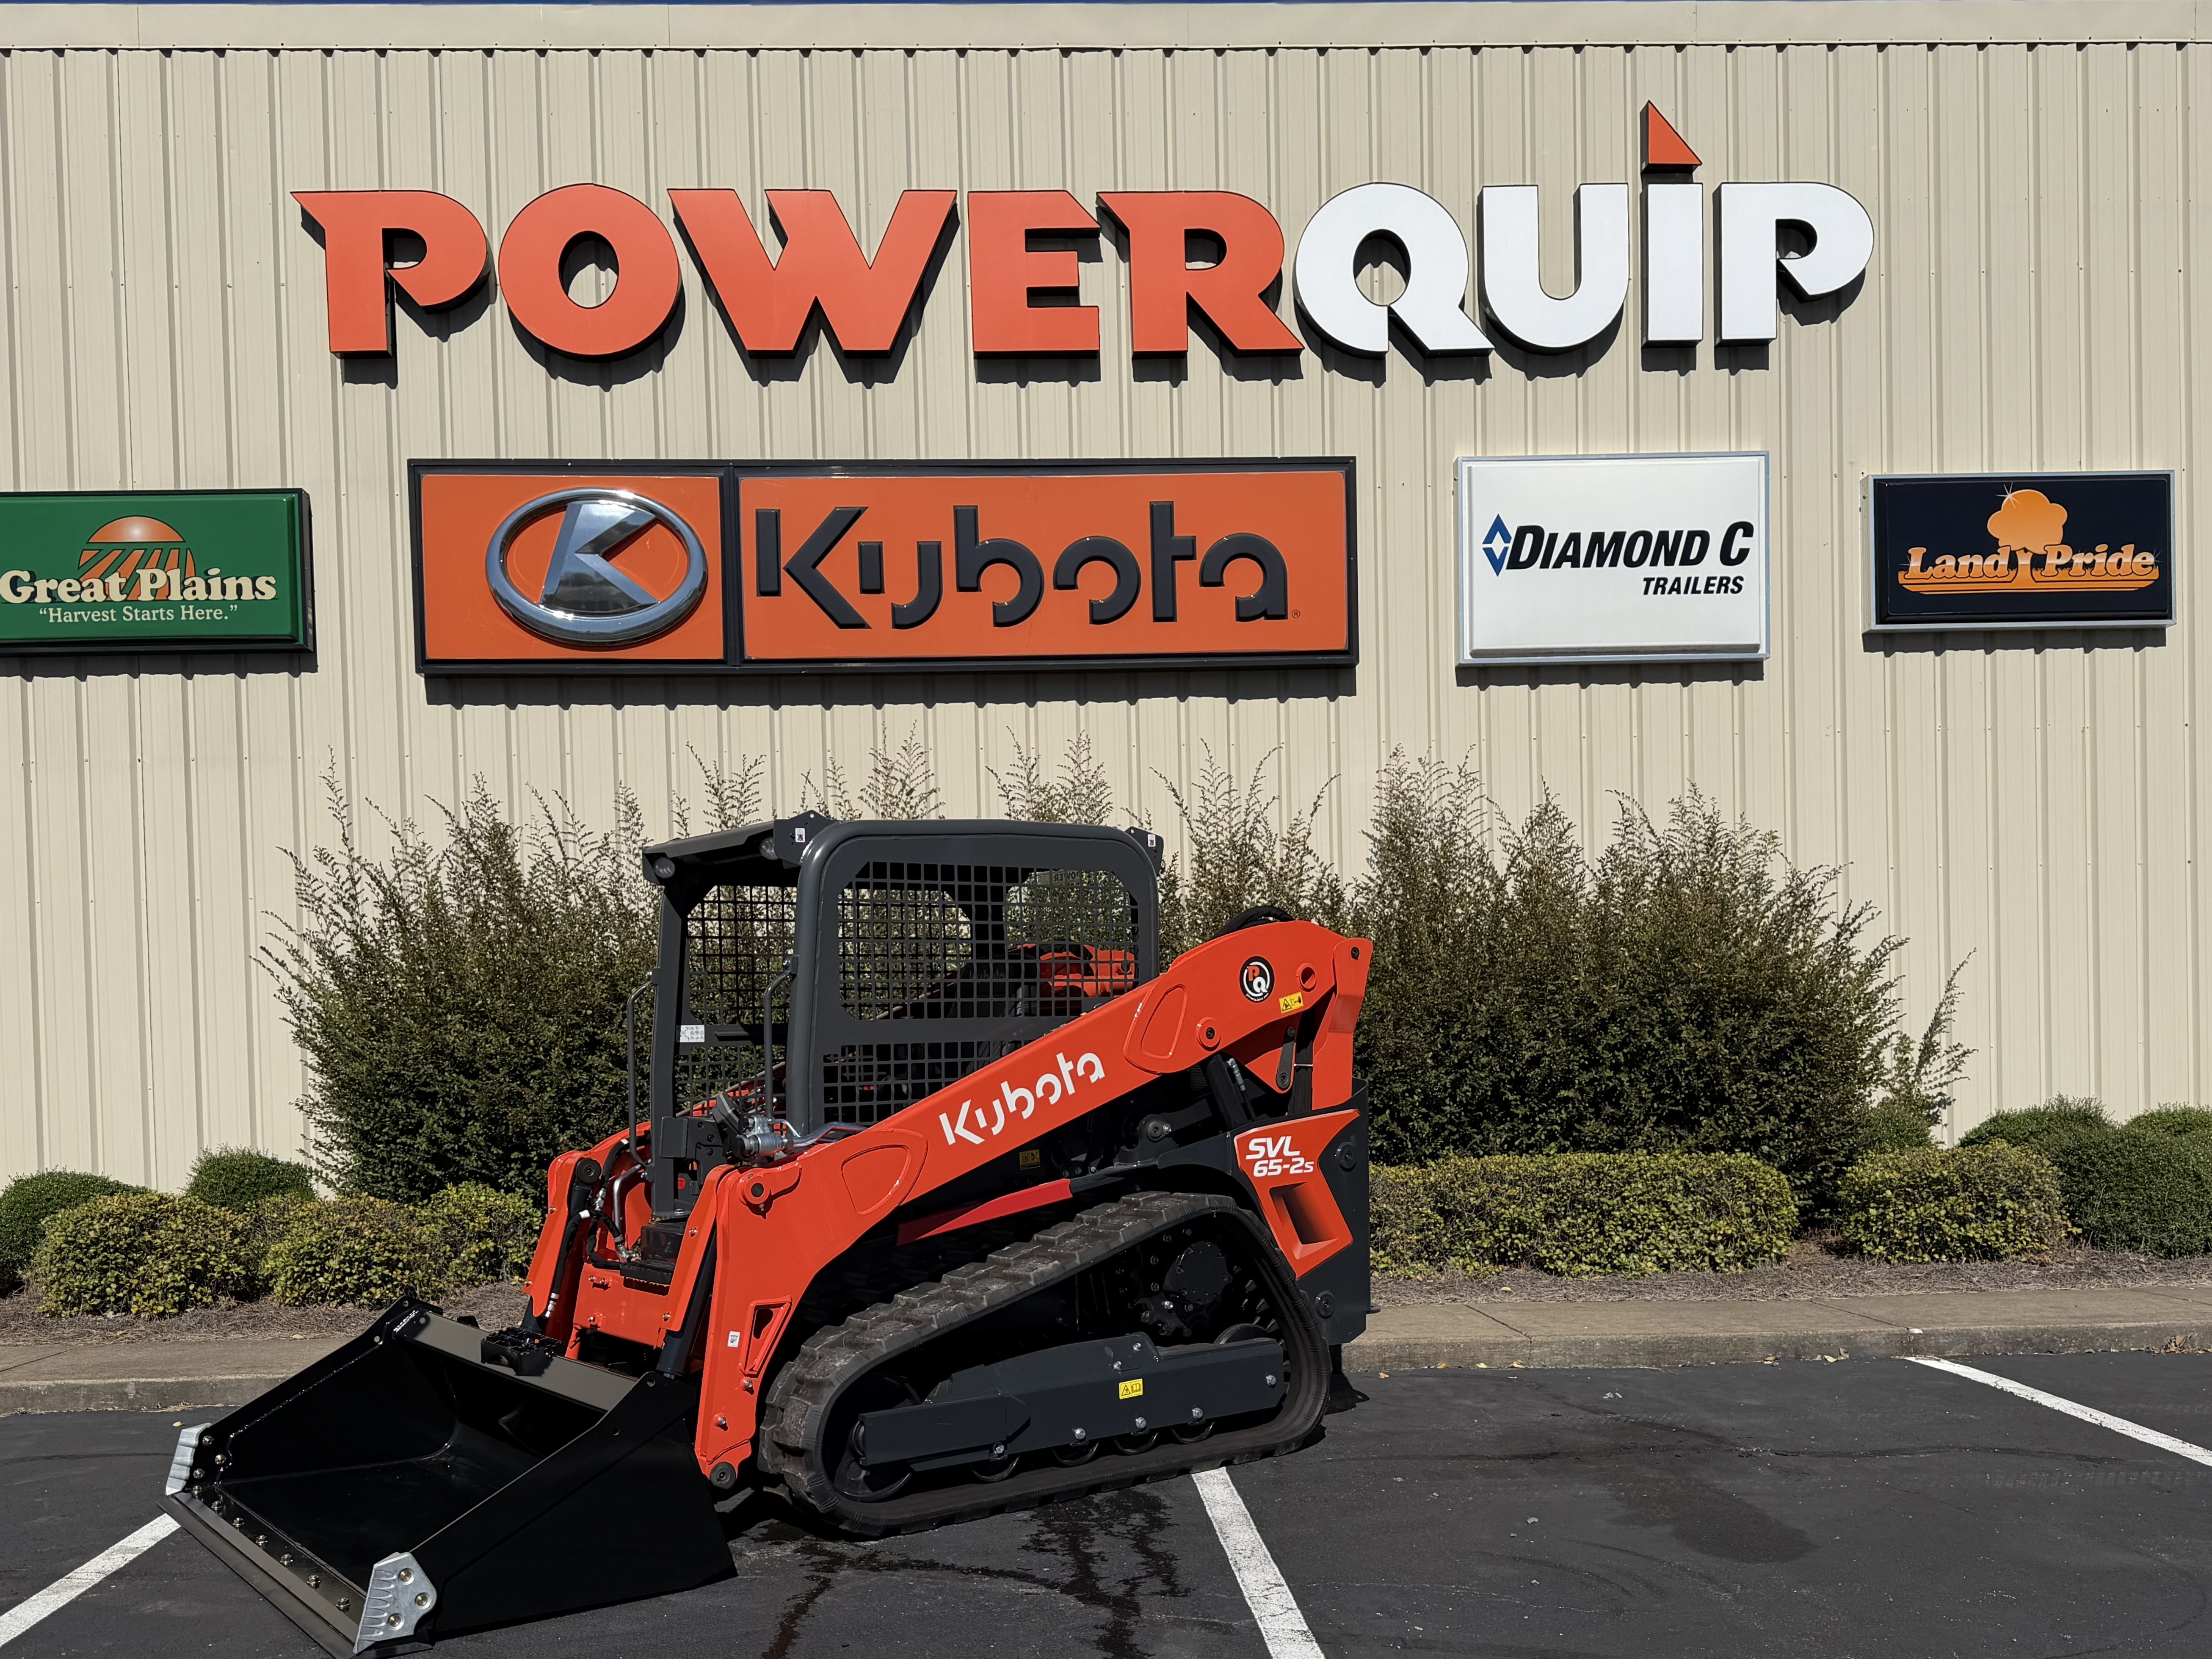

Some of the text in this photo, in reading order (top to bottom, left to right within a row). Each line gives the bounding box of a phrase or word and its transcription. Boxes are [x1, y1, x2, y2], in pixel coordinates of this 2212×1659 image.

[1506, 521, 1754, 570] DIAMOND C
[1904, 543, 2155, 579] Land Pride
[0, 568, 276, 604] Great Plains
[1643, 575, 1744, 595] TRAILERS
[122, 606, 174, 621] Starts
[939, 1052, 1105, 1145] Kubota
[1245, 1136, 1301, 1160] SVL
